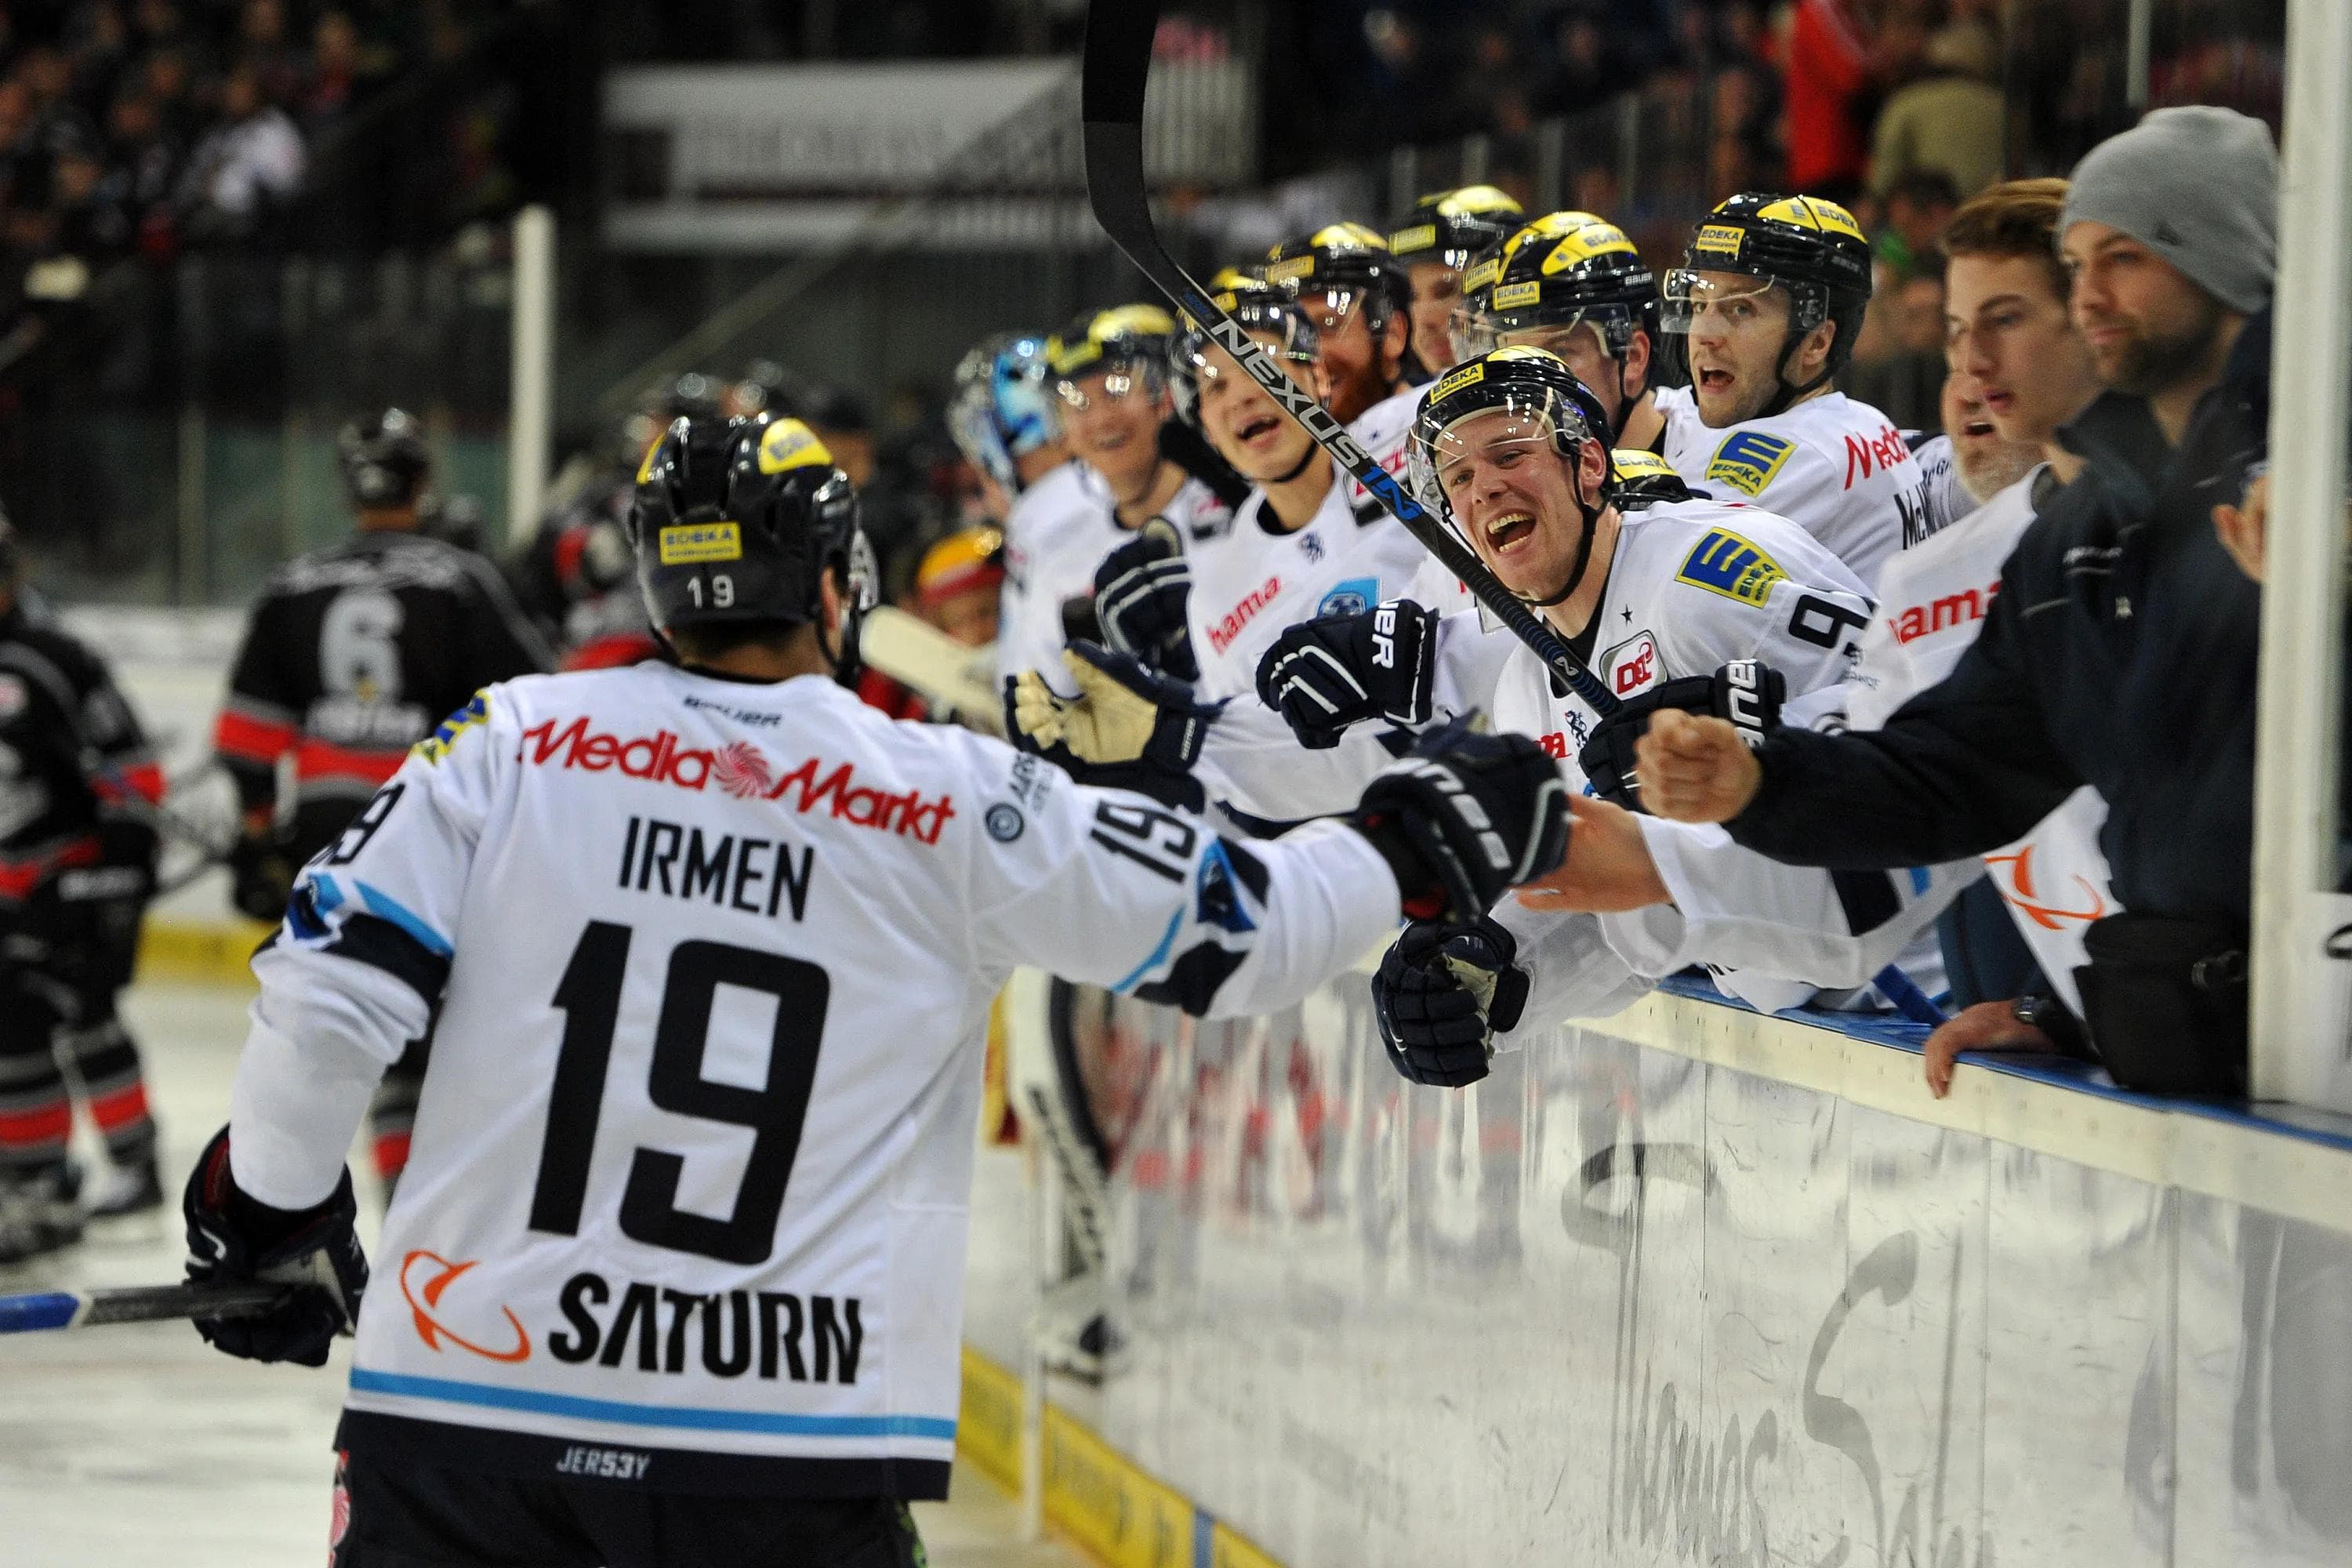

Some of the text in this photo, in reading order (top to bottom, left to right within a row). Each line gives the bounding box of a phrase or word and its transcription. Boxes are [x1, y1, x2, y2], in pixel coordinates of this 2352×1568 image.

[1701, 228, 1739, 240] EDEKA
[1210, 318, 1367, 468] NEXUS
[1433, 366, 1479, 394] EDEKA
[1711, 463, 1762, 488] EDEKA
[315, 590, 406, 702] 6
[687, 575, 735, 609] 19
[517, 716, 714, 792] Media
[767, 757, 956, 846] Markt
[619, 815, 815, 923] IRMEN
[1091, 799, 1196, 885] 19
[528, 919, 830, 1266] 19
[547, 1271, 862, 1386] SATURN
